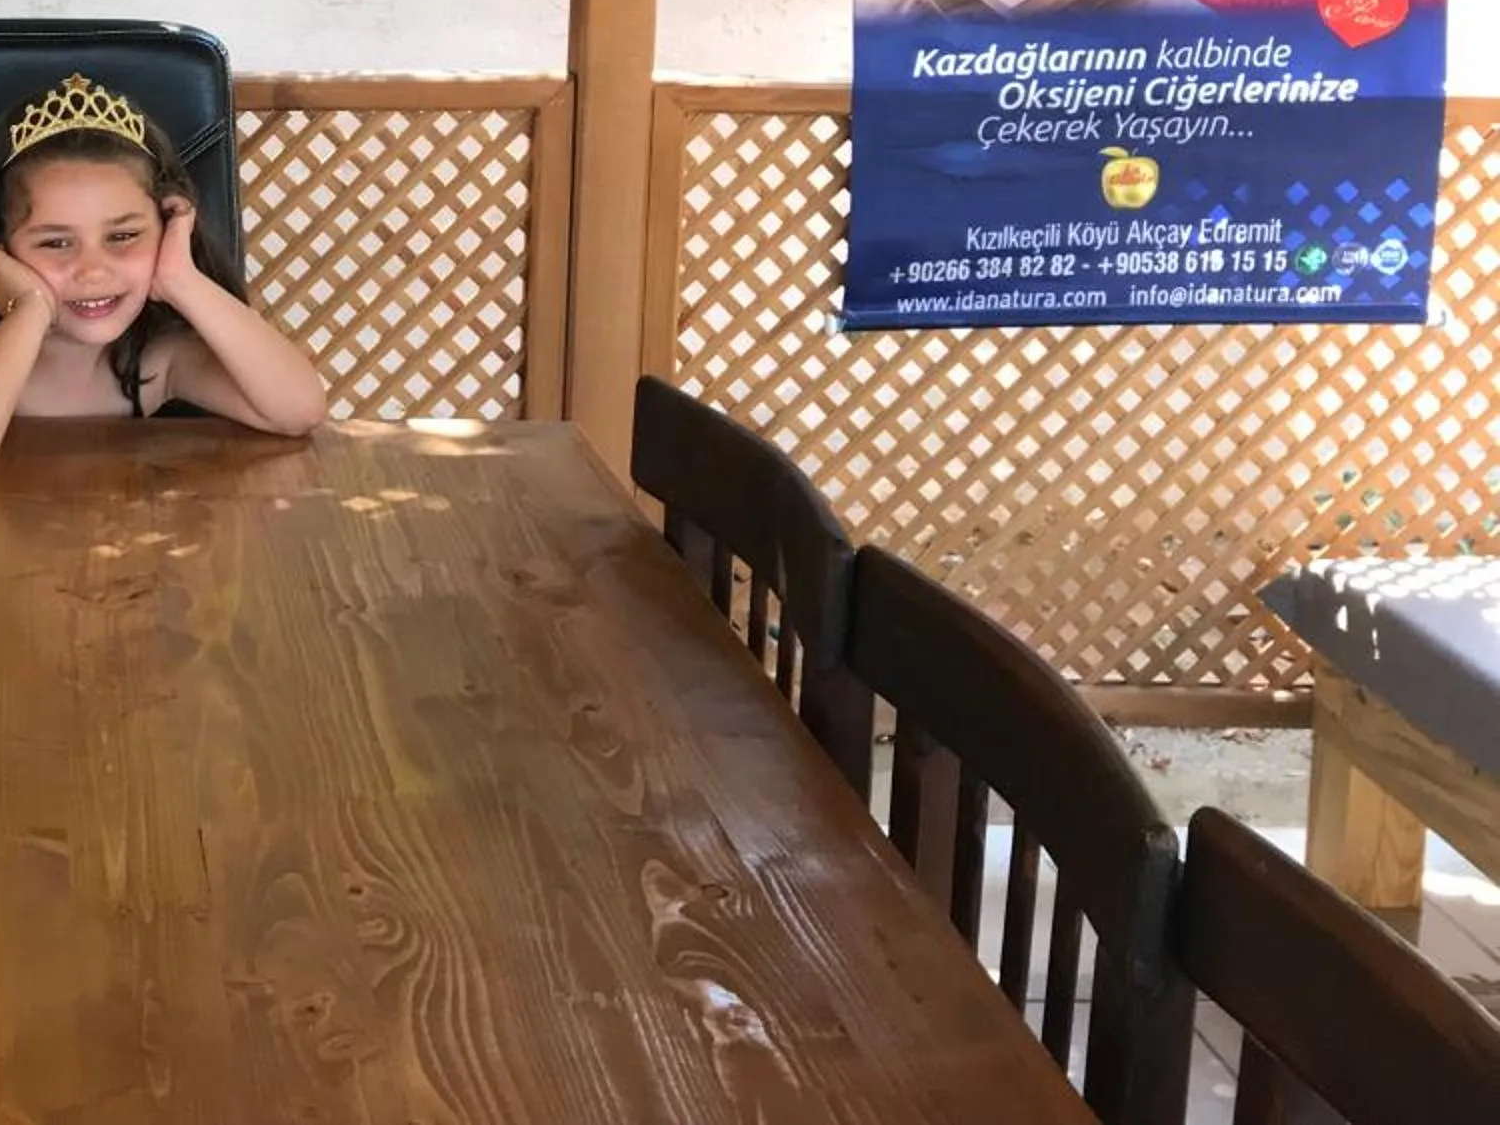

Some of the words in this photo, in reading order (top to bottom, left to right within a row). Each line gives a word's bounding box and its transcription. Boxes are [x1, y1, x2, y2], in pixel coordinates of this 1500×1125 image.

[912, 41, 1147, 79] Kazdağlarının
[1155, 36, 1293, 70] kalbinde
[998, 76, 1136, 114] Oksijeni
[1144, 73, 1359, 113] Ciğerlerinize
[977, 112, 1102, 150] Çekerek
[966, 223, 1061, 253] Kızılkeçili
[1067, 221, 1119, 250] Köyü
[1125, 220, 1192, 249] Akçay
[1197, 218, 1282, 244] Edremit
[889, 259, 970, 284] +90266
[976, 256, 1013, 280] 384
[1020, 255, 1044, 277] 82
[1050, 254, 1076, 276] 82
[1098, 251, 1178, 275] +90538
[1232, 250, 1255, 272] 15
[1263, 250, 1287, 272] 15
[897, 289, 1106, 314] www.idanatura.com
[1130, 284, 1342, 307] info@idanatura.com
